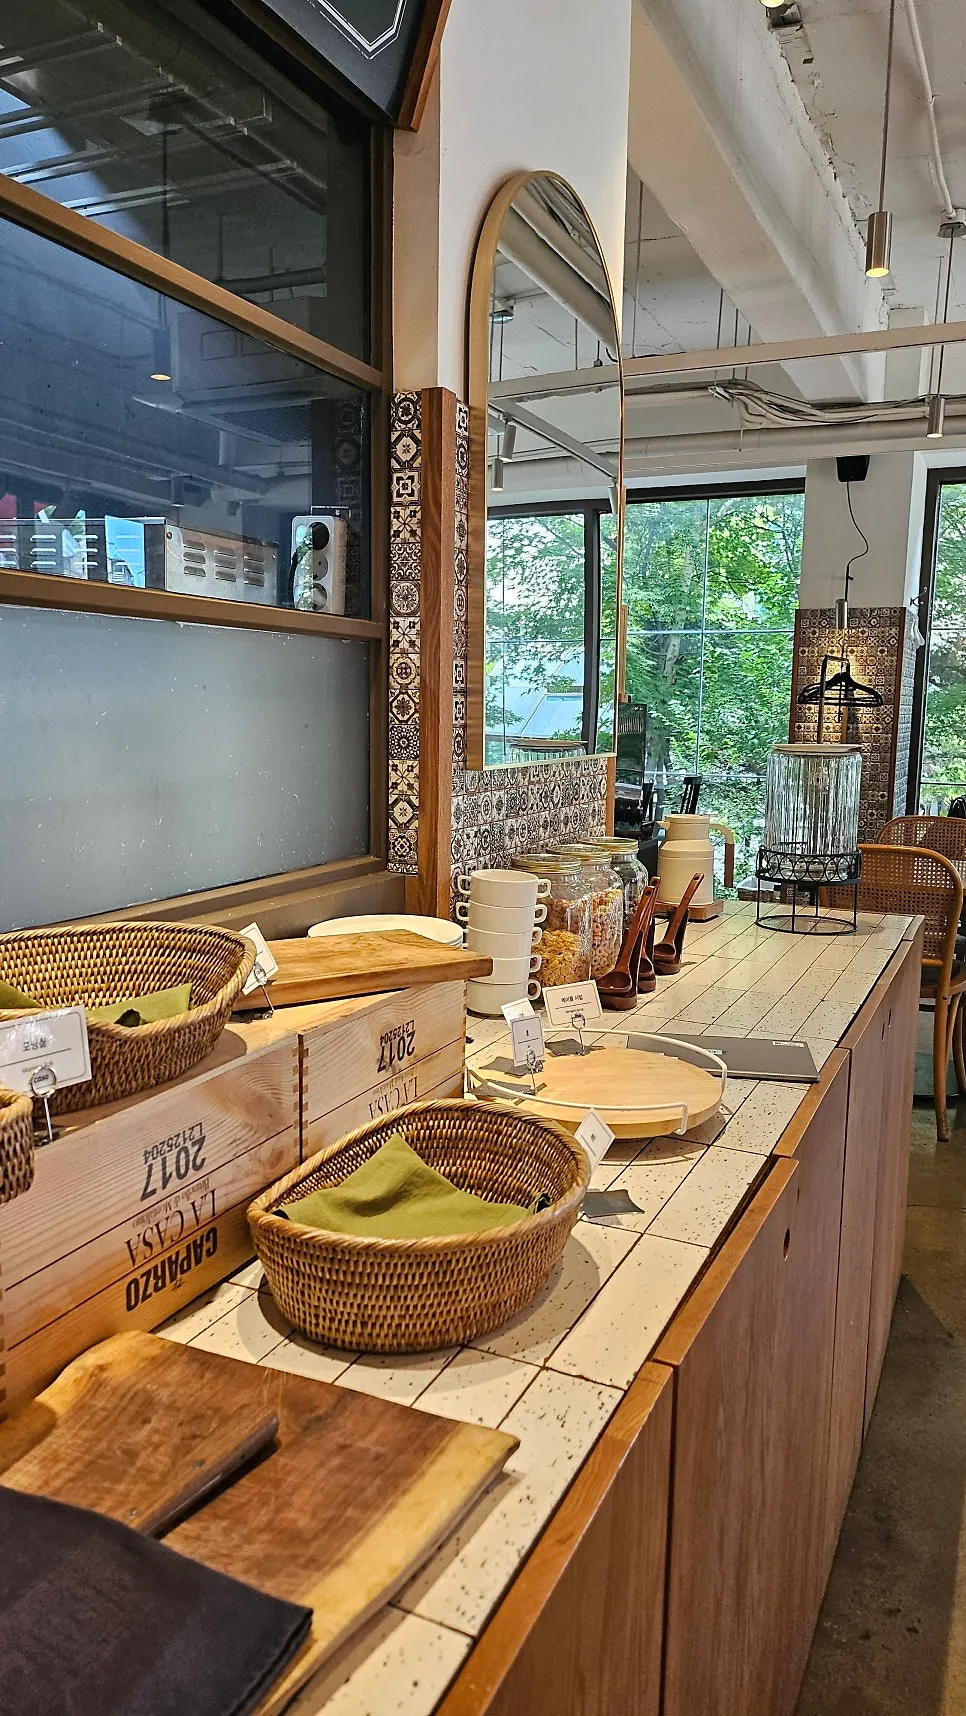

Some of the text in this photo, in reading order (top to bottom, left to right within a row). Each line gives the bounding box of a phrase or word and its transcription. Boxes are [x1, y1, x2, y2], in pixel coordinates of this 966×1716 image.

[377, 1030, 416, 1074] 2017
[380, 1020, 415, 1047] L2125204
[368, 1087, 401, 1120] CASA
[403, 1076, 418, 1103] LA
[143, 1122, 203, 1165] L2125204
[140, 1135, 206, 1202] 2017
[125, 1188, 217, 1268] LA CASA
[125, 1226, 218, 1312] CAPARZO
